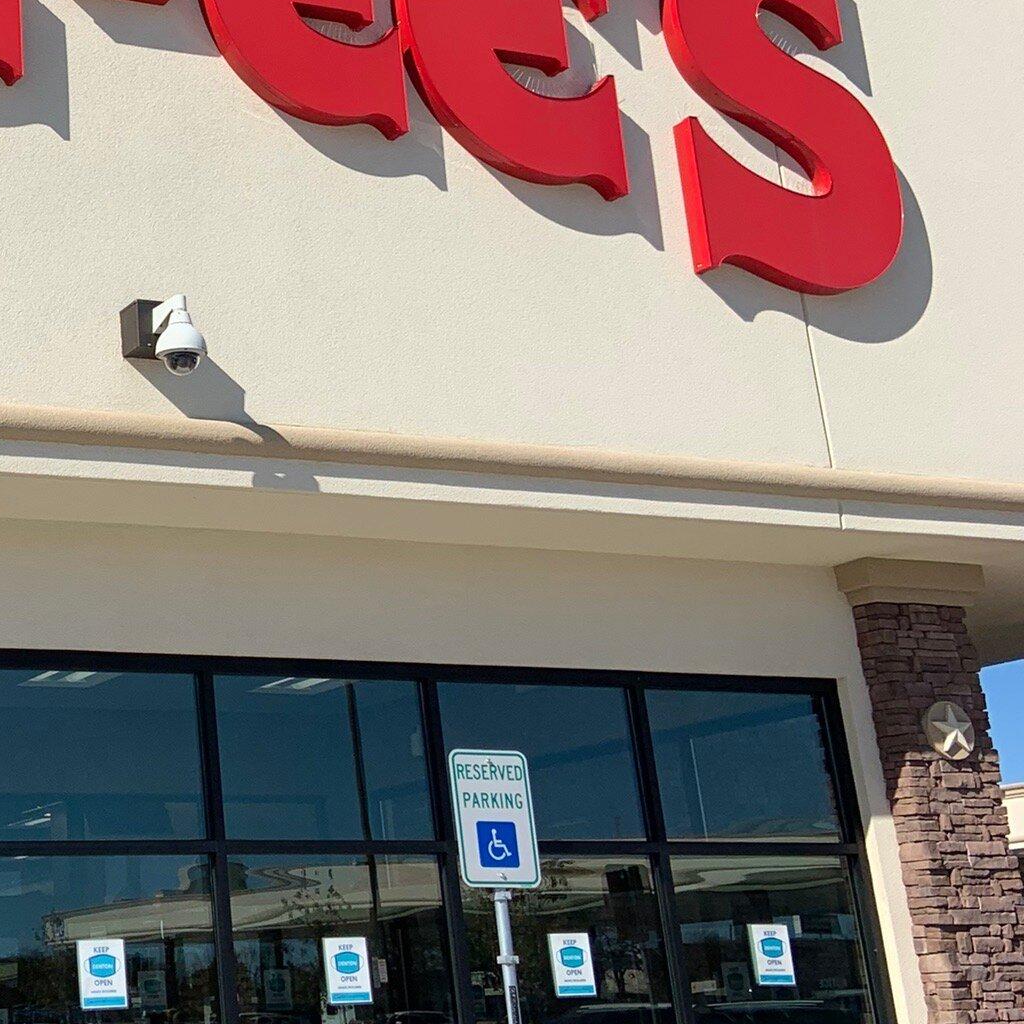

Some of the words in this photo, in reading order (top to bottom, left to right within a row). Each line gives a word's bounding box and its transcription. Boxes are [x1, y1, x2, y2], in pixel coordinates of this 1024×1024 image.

[456, 763, 523, 781] RESERVED
[462, 792, 523, 809] PARKING
[338, 943, 353, 951] KEEP
[94, 979, 113, 987] OPEN
[340, 975, 358, 983] OPEN
